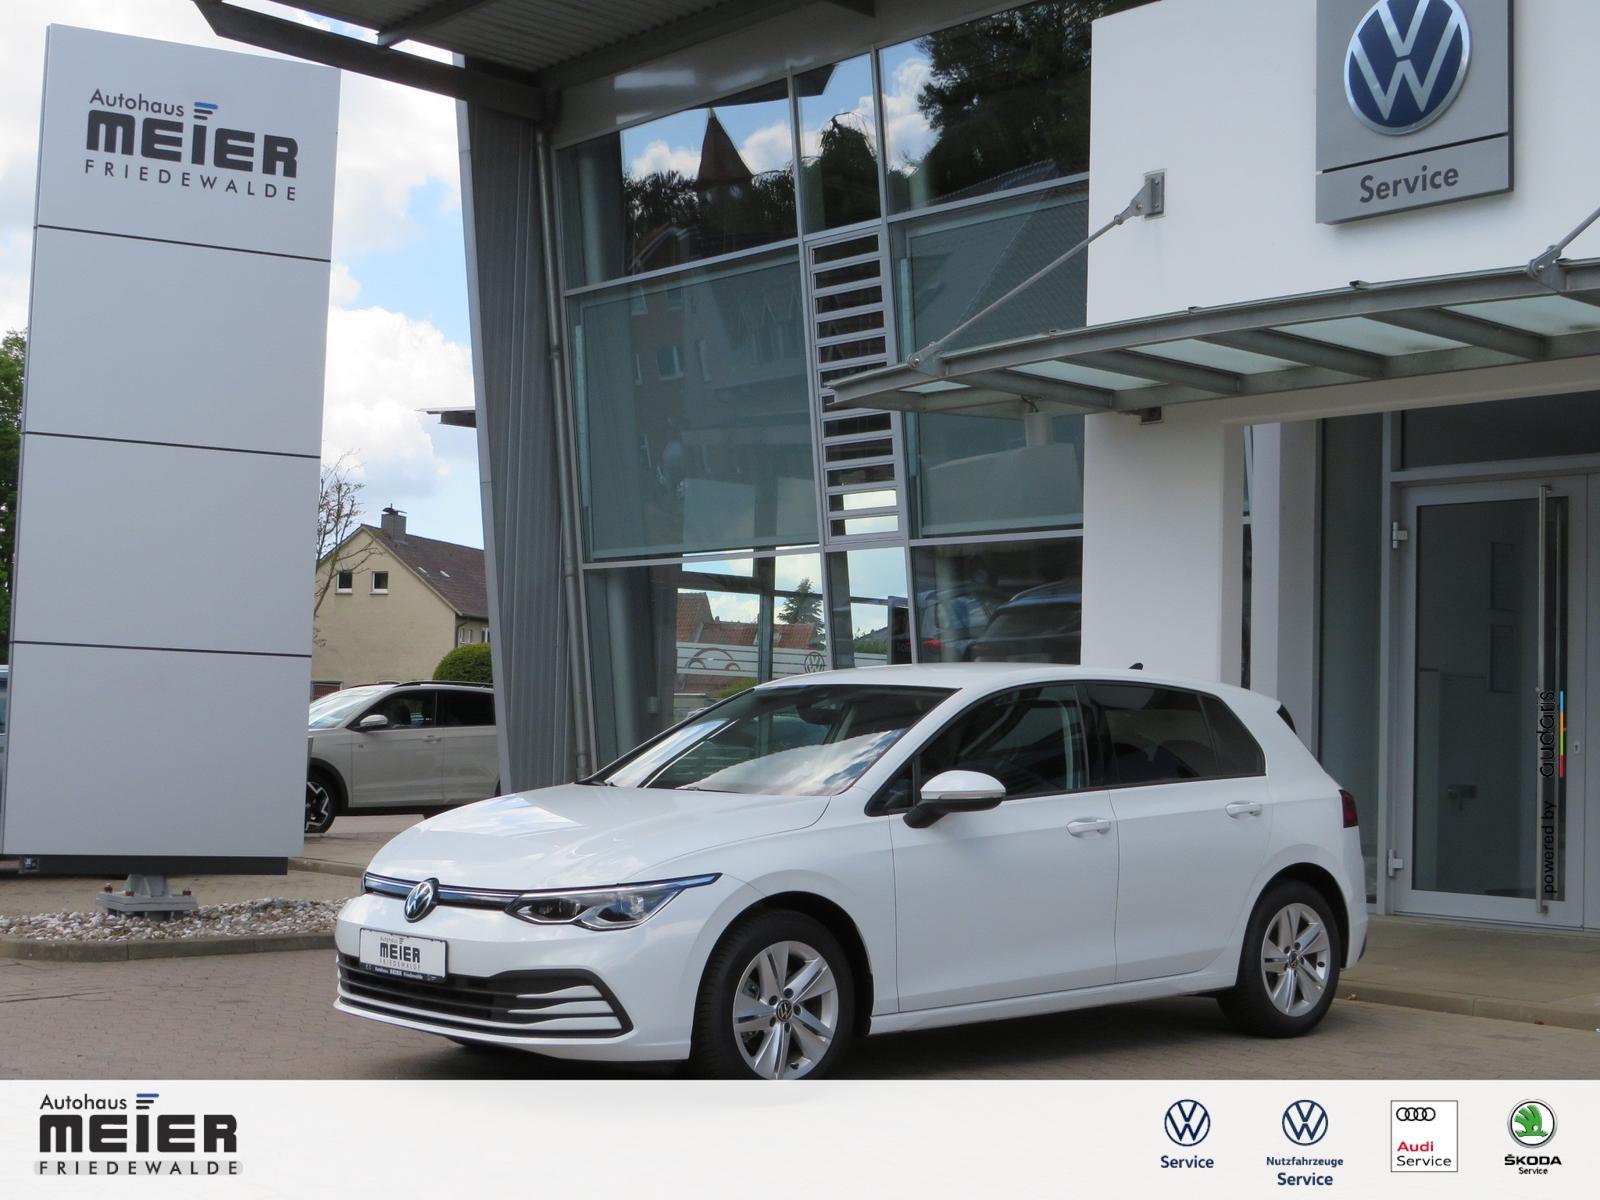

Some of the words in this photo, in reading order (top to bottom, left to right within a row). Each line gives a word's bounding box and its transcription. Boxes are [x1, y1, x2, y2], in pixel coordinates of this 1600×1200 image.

[89, 88, 185, 117] Autohaus
[86, 107, 299, 179] MEIER
[85, 159, 296, 202] FRIEDEWALDE
[1359, 165, 1459, 204] Service
[380, 942, 421, 964] MEIER
